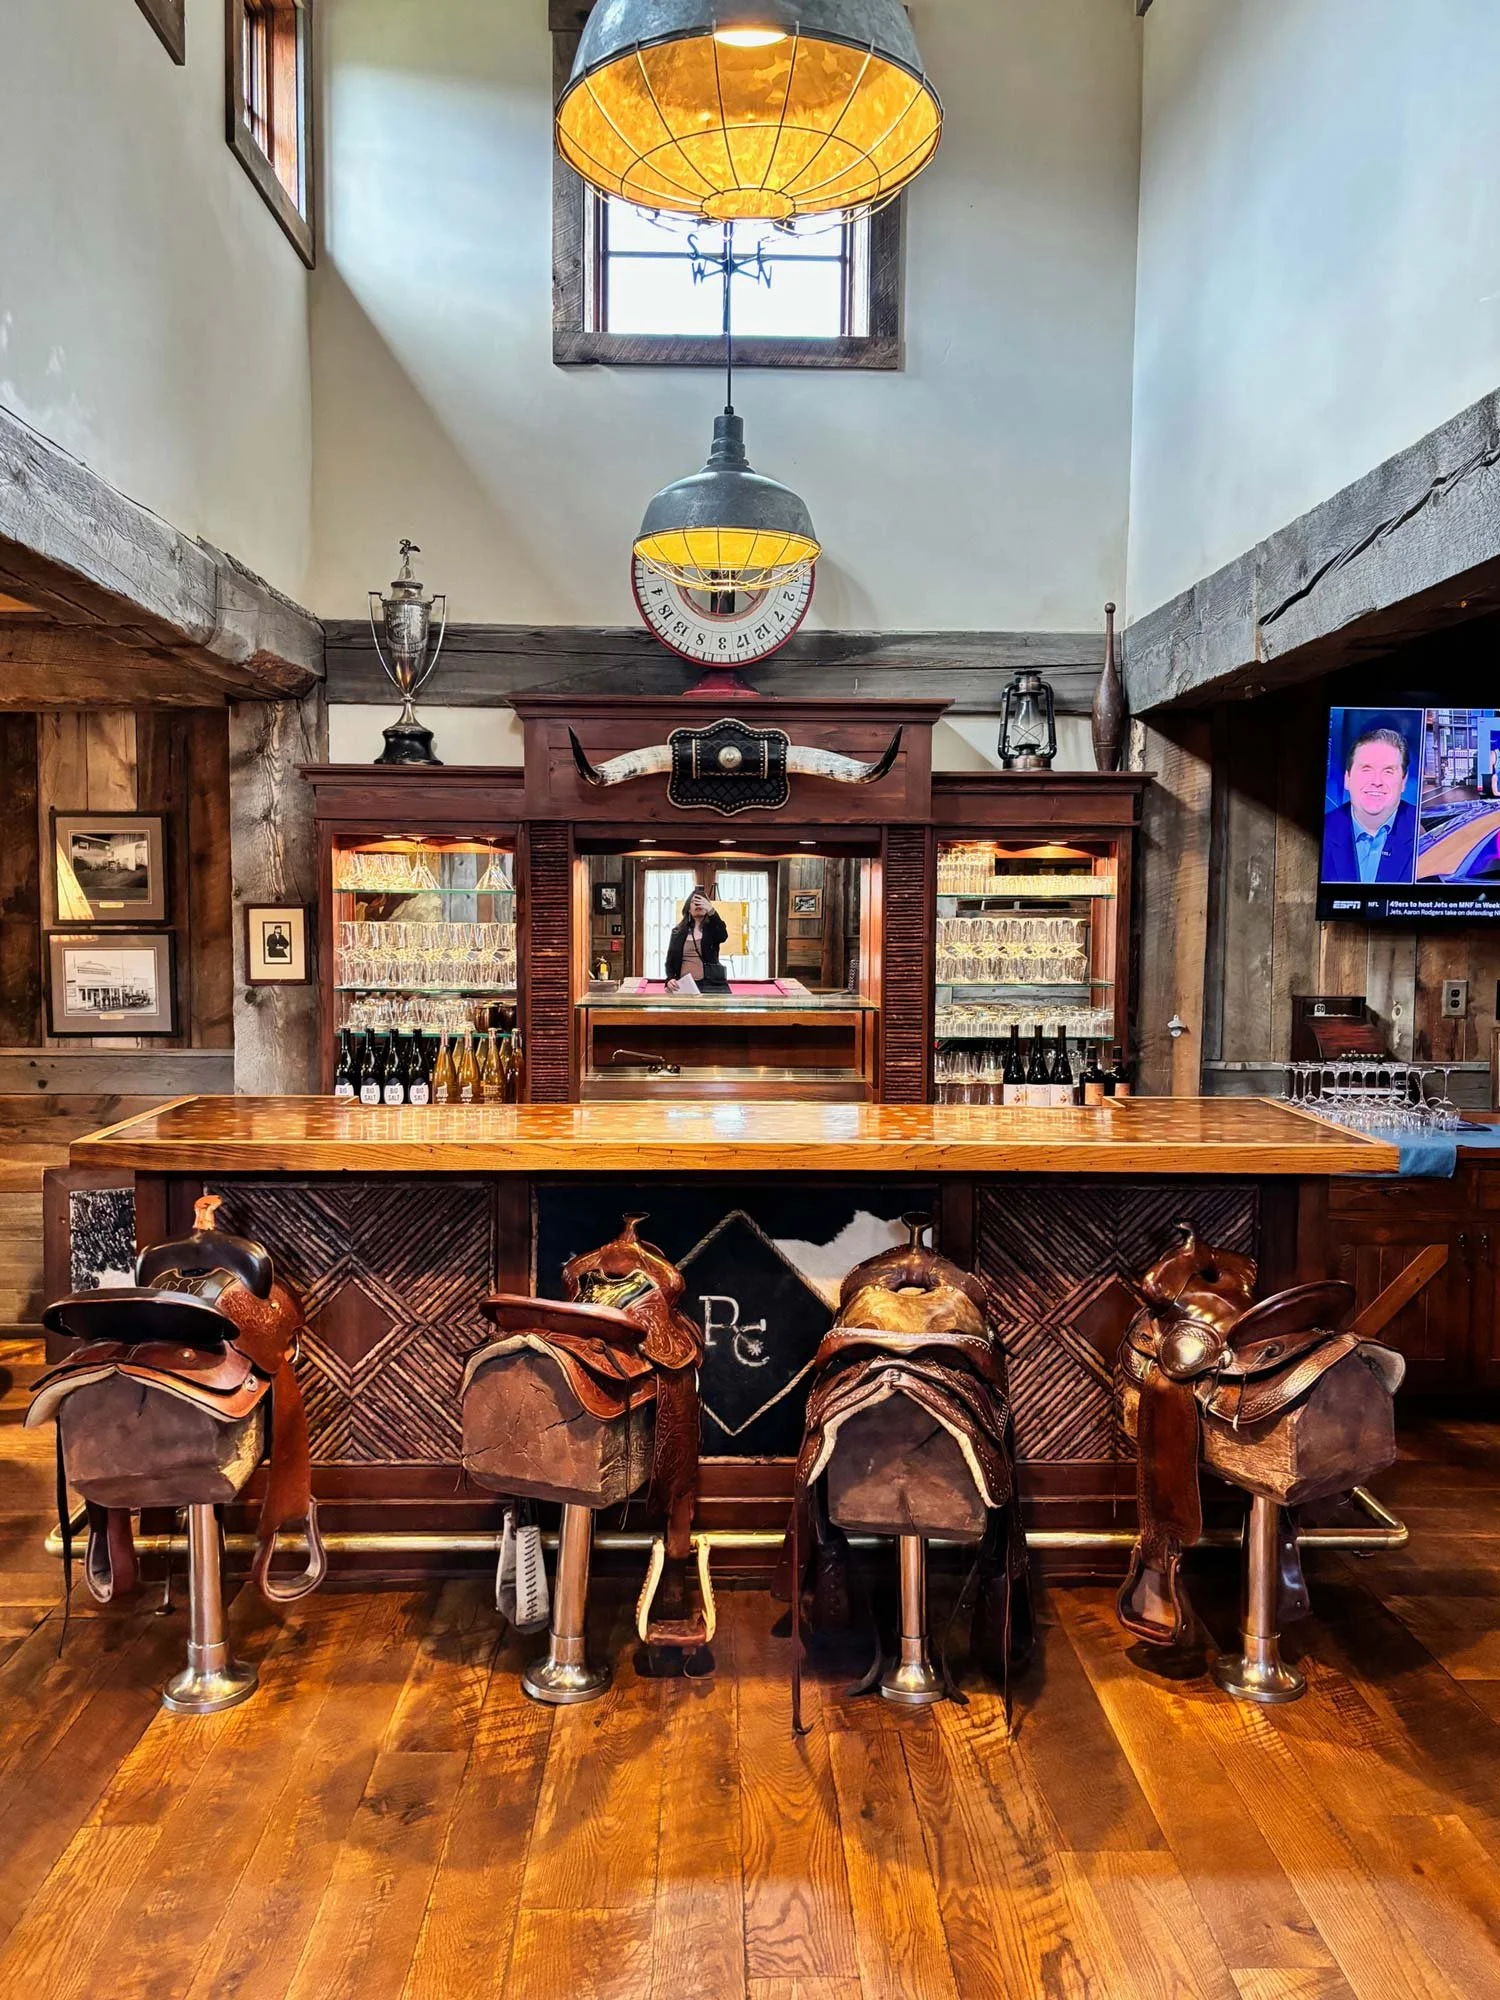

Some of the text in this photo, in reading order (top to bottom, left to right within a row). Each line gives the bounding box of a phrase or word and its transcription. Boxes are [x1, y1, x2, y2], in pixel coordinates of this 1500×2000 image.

[687, 233, 699, 260] S
[691, 260, 707, 285] W
[757, 264, 773, 289] N
[651, 587, 664, 596] 4
[783, 590, 795, 602] 2
[658, 604, 674, 620] 18
[774, 610, 785, 623] 7
[673, 621, 690, 637] 13
[754, 623, 771, 640] 12
[695, 632, 706, 646] 8
[718, 636, 727, 650] 3
[736, 633, 751, 648] 17
[1333, 900, 1361, 909] ESPN
[1389, 900, 1408, 908] 49ers
[1421, 909, 1444, 917] Rodgers
[1466, 909, 1494, 917] defending
